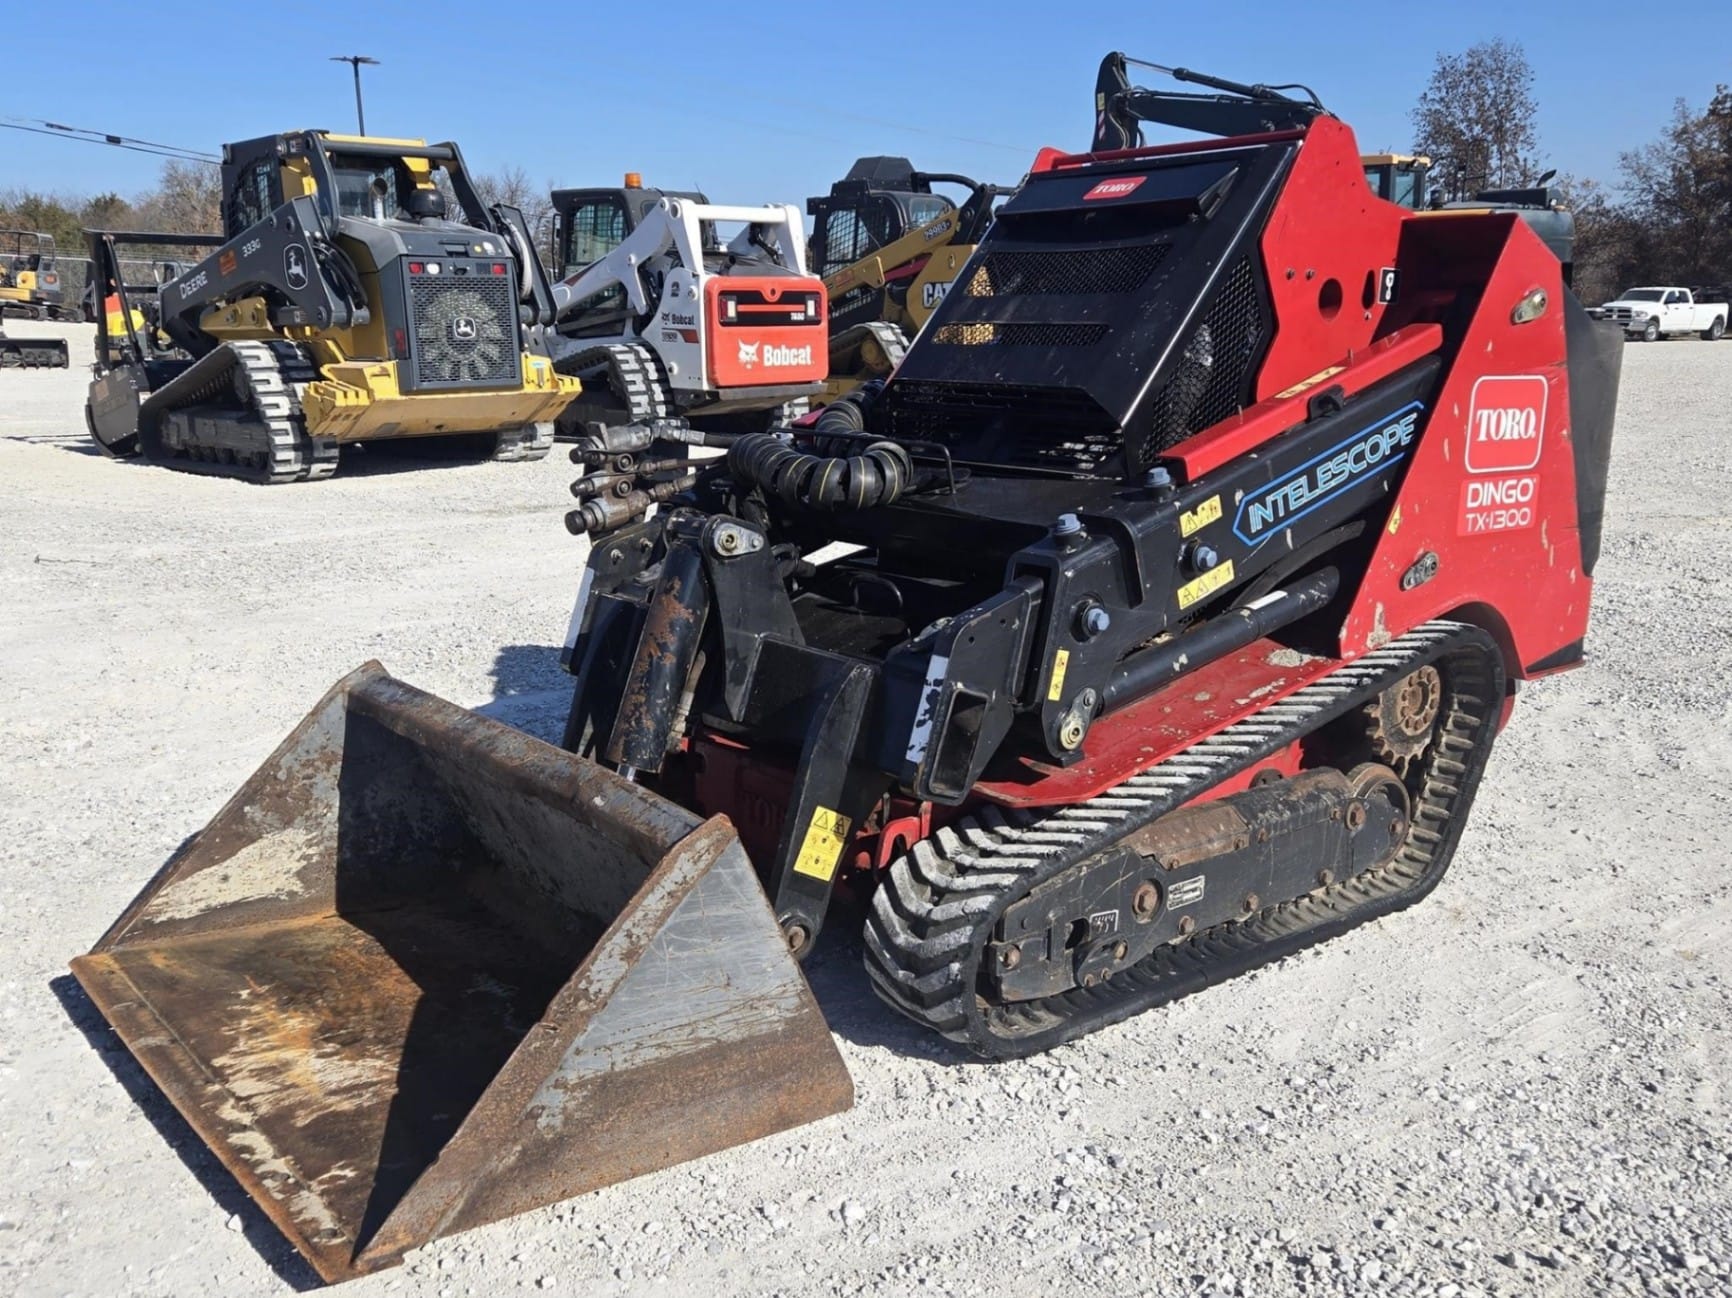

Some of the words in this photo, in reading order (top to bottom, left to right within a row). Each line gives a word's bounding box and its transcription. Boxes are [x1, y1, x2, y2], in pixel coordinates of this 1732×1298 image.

[180, 271, 208, 299] DEERE
[671, 313, 695, 326] Bobcat
[763, 344, 812, 367] Bobcat
[1475, 407, 1536, 442] TORO
[1248, 412, 1418, 533] INTELESCOPE
[1466, 478, 1534, 508] DINGO
